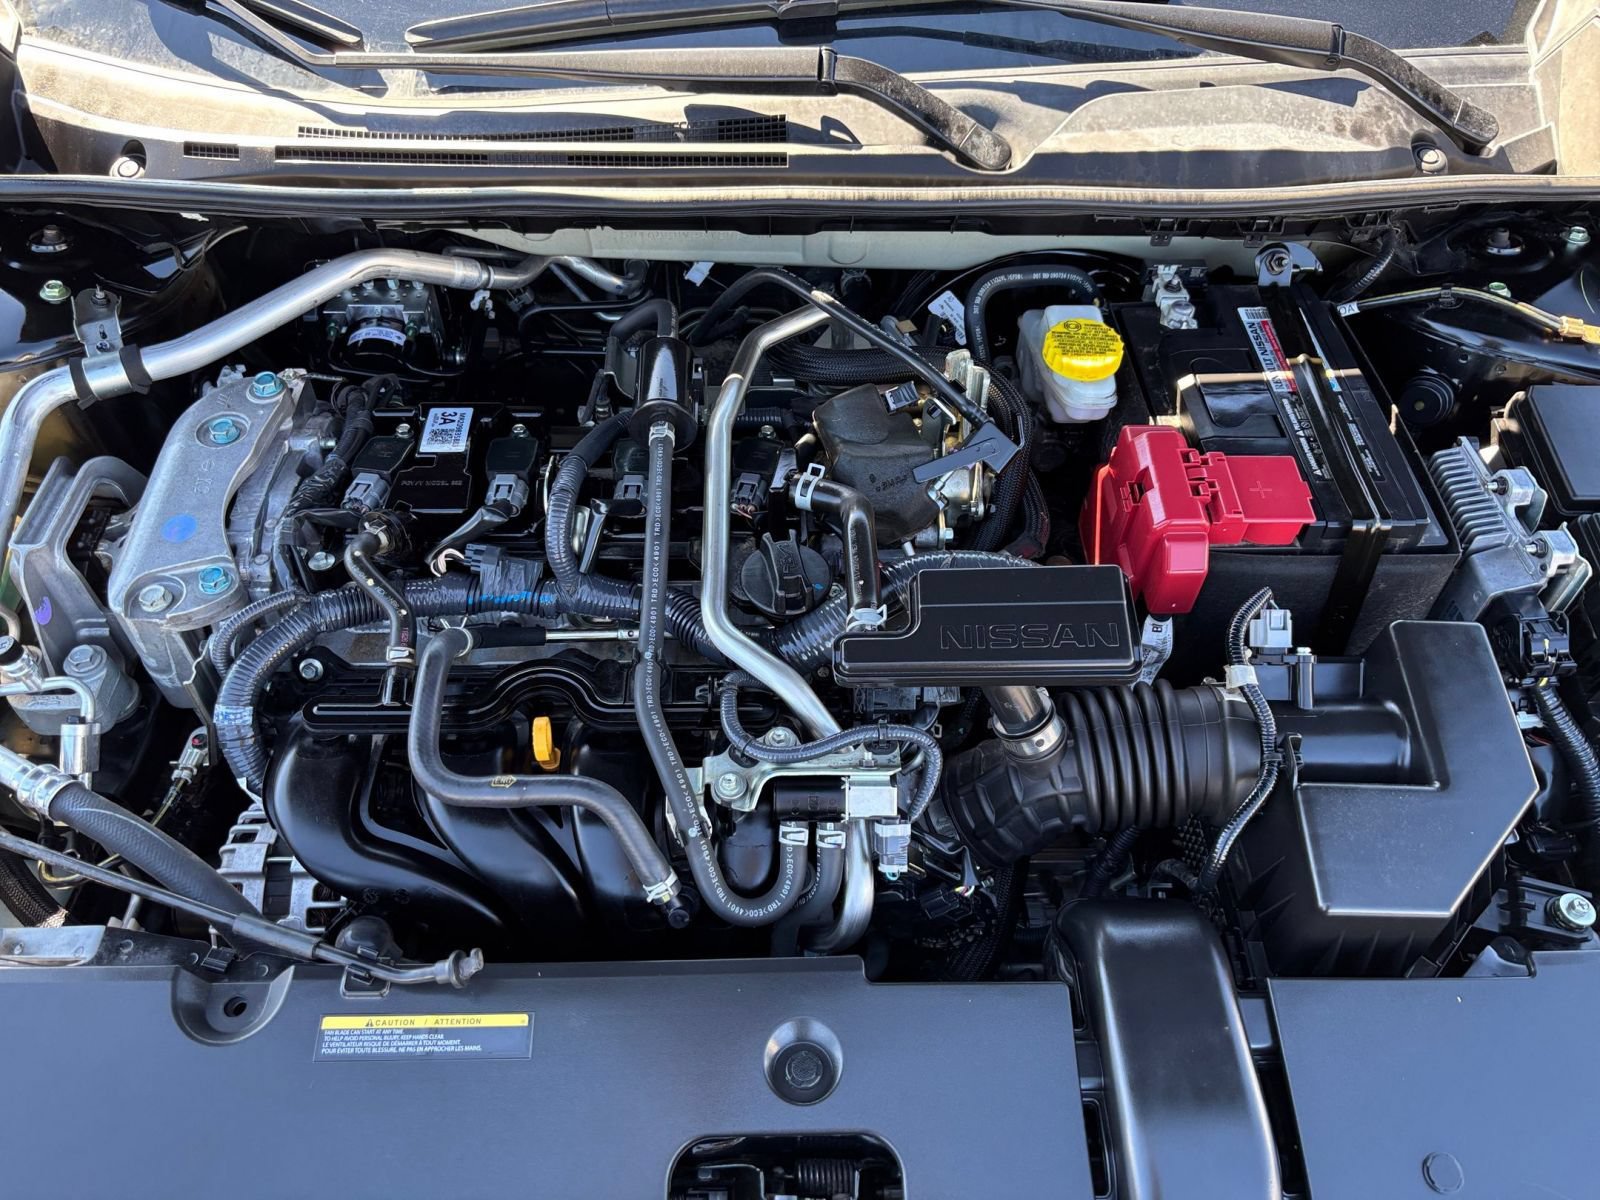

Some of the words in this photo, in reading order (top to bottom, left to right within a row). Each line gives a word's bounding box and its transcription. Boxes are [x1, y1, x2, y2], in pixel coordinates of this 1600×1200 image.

[1246, 321, 1269, 357] NISSAN
[1262, 356, 1285, 390] RENULT
[438, 411, 458, 426] 3A
[651, 541, 661, 602] TRD>ECO<4901
[940, 623, 1120, 649] NISSAN
